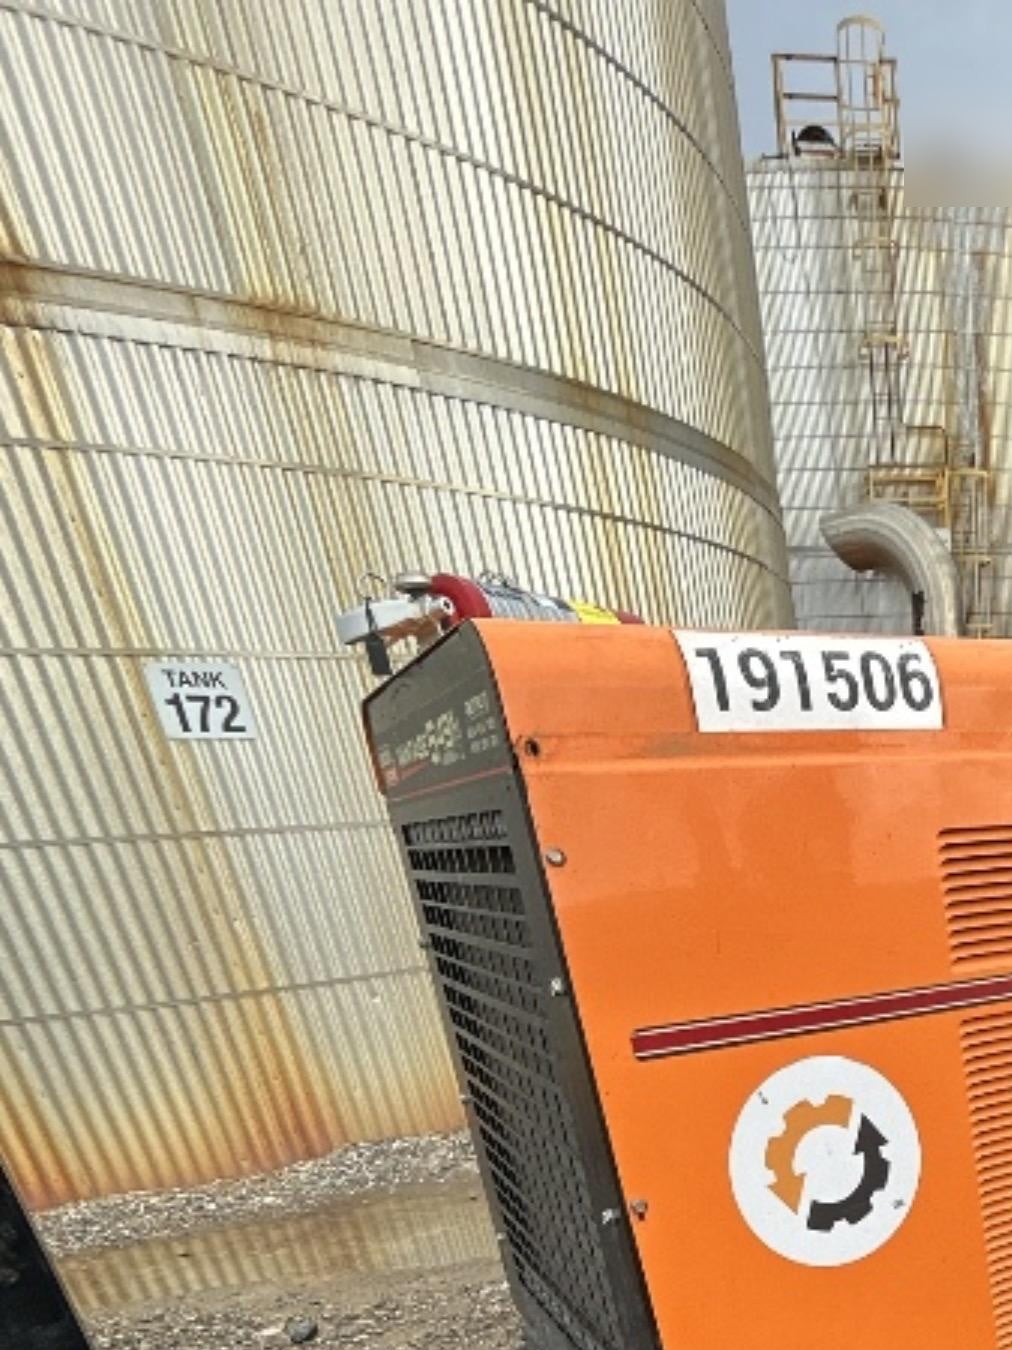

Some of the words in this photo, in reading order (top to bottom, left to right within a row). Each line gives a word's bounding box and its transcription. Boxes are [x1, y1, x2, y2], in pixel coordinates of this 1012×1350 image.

[161, 669, 228, 690] TANK
[695, 647, 934, 712] 191506
[164, 692, 247, 732] 172
